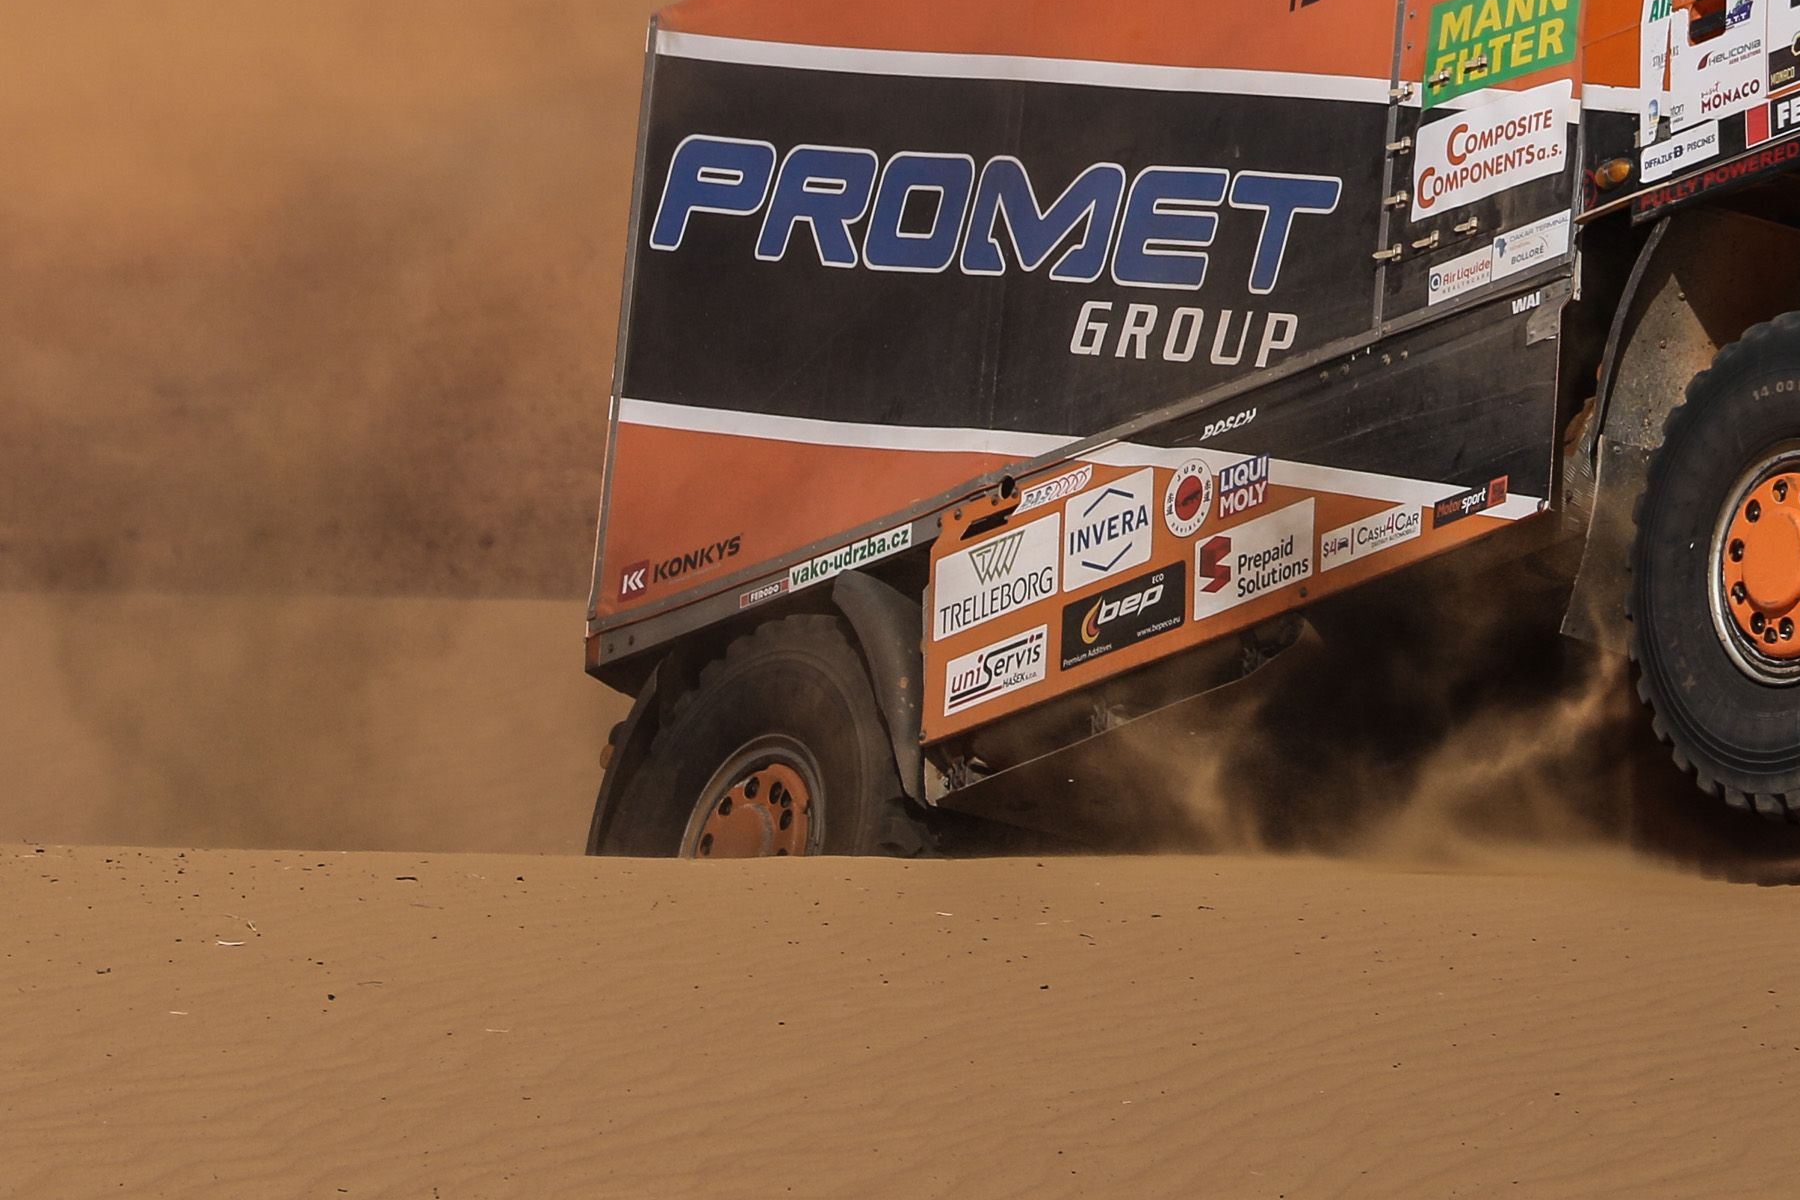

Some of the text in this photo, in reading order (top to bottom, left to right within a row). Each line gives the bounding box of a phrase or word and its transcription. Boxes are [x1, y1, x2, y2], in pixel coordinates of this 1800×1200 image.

[1430, 17, 1565, 95] FILTER
[1701, 79, 1761, 114] MONACO
[1686, 133, 1716, 152] PISCINES
[1640, 175, 1699, 211] FULLY
[1702, 140, 1799, 190] POWERED
[650, 134, 1343, 295] PROMET
[1070, 300, 1299, 368] GROUP
[1200, 407, 1257, 441] BOSCH
[1220, 455, 1268, 493] LIQUI
[1219, 480, 1268, 519] MOLY
[1069, 505, 1149, 556] INVERA
[652, 535, 741, 584] KONKYS
[791, 527, 910, 587] vako-udrzba.cz
[1237, 534, 1294, 576] Prepaid
[750, 583, 780, 602] FERODO
[940, 566, 1054, 635] TRELLEBORG
[1237, 557, 1309, 599] Solutions
